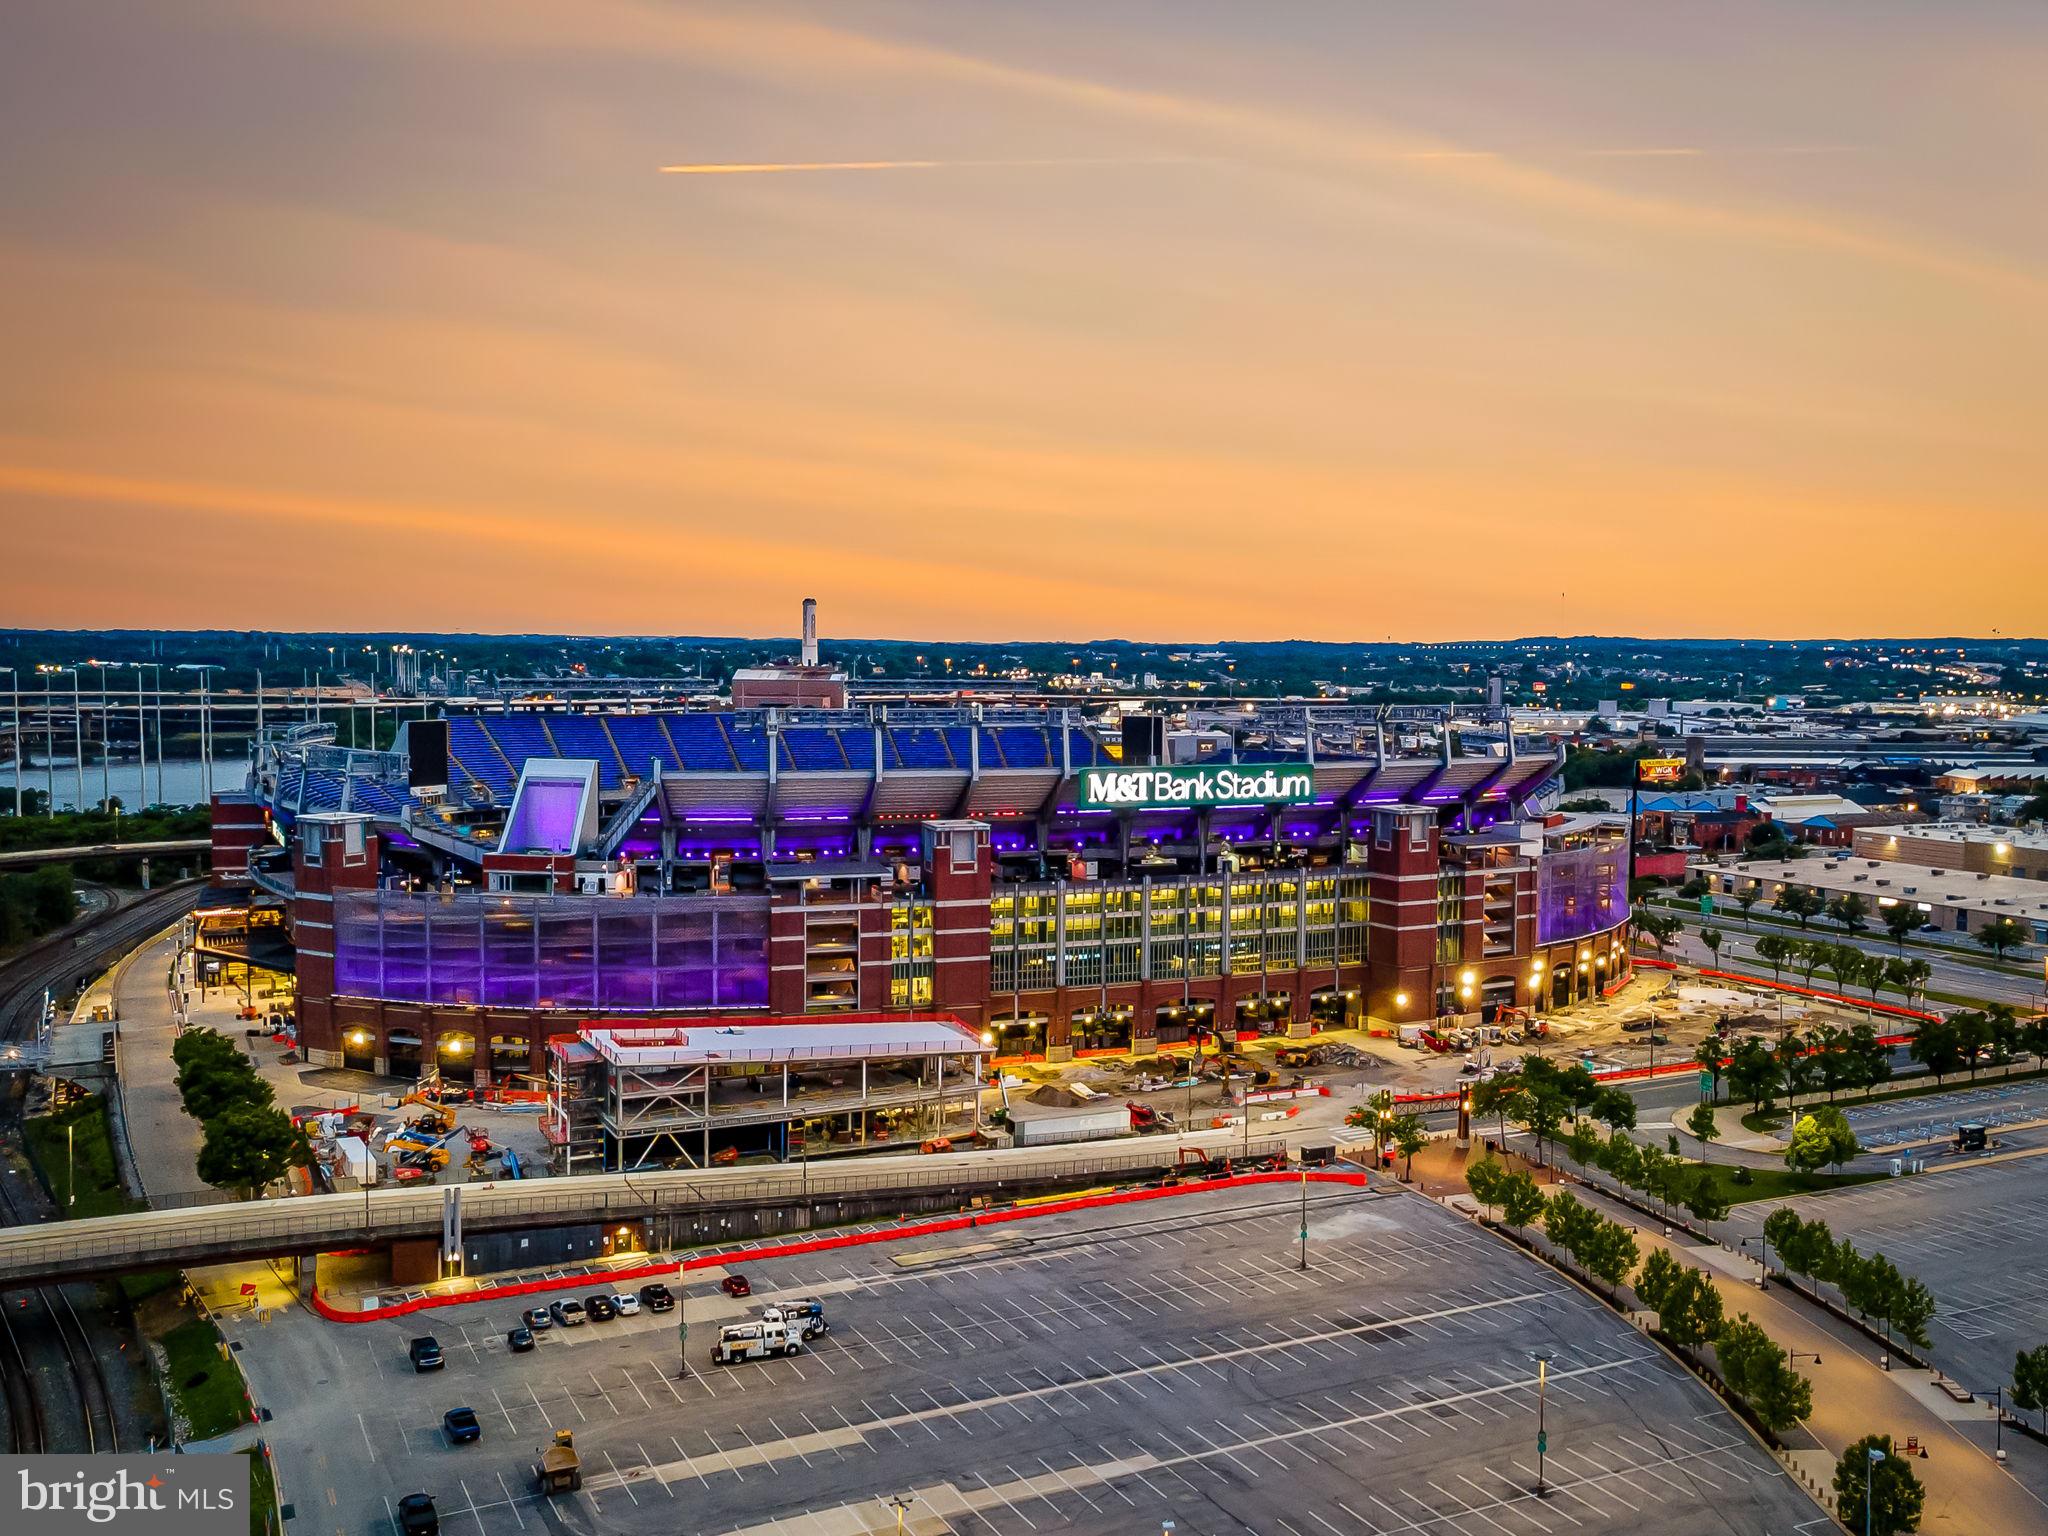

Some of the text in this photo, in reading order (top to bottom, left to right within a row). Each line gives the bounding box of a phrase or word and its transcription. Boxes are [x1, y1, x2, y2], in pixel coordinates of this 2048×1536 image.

[1088, 770, 1310, 802] M&T Bank Stadium
